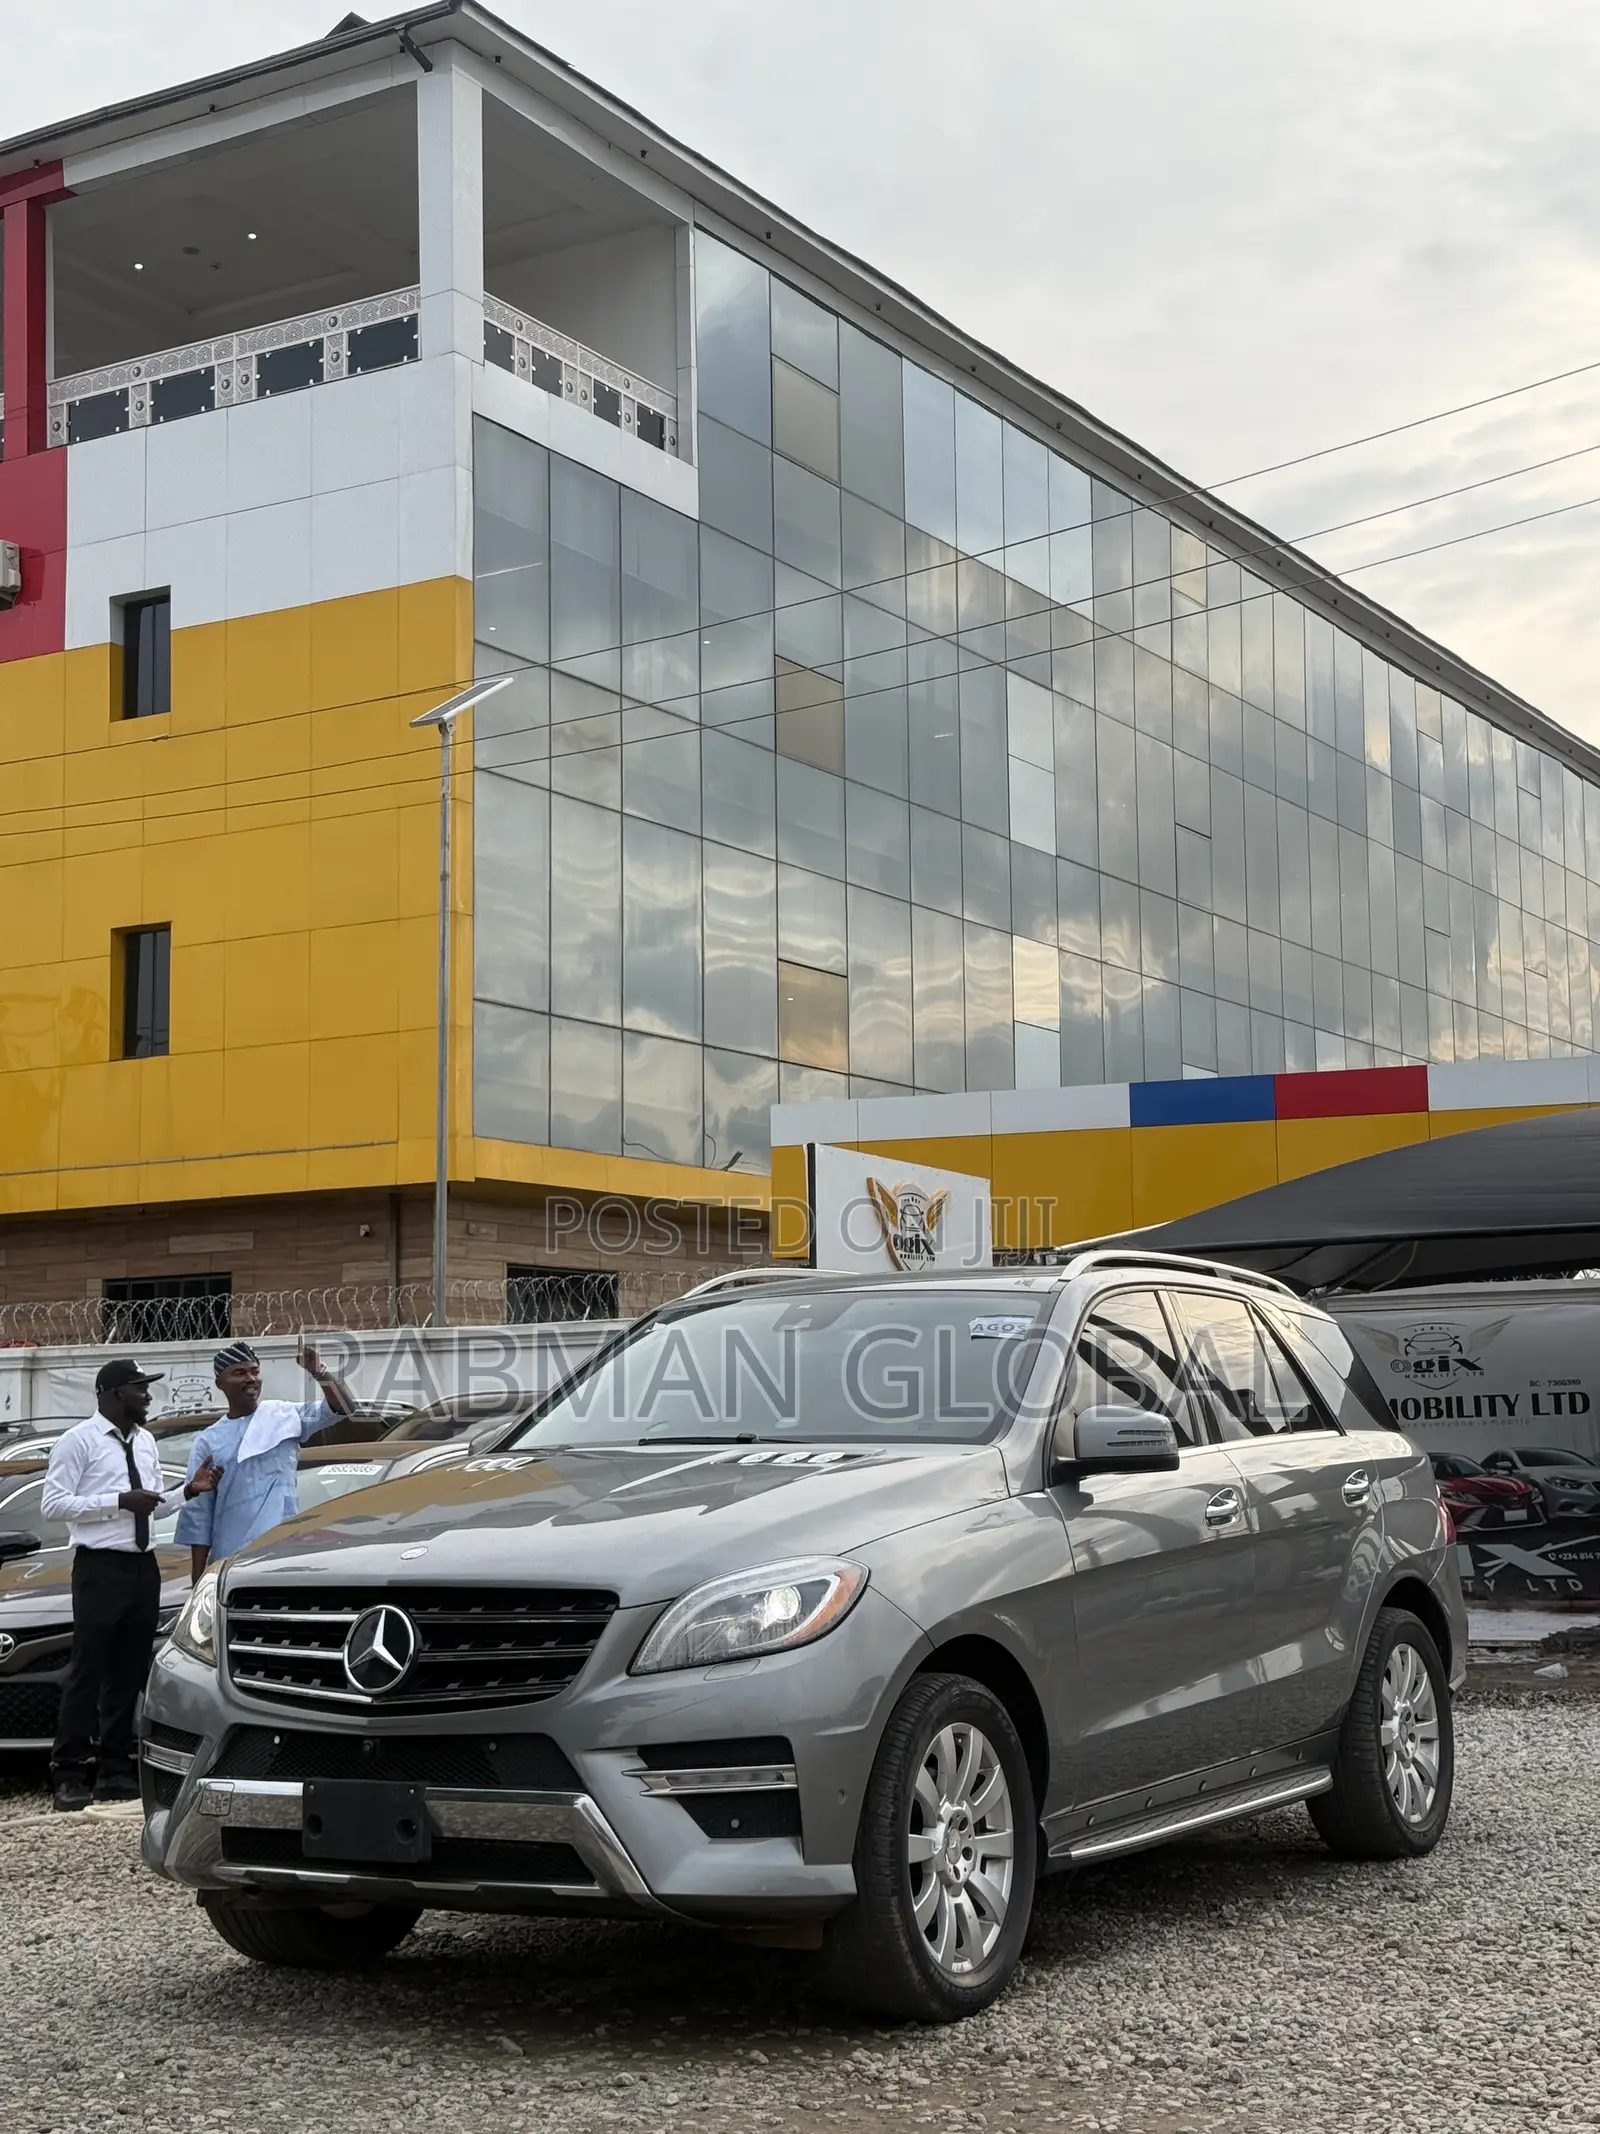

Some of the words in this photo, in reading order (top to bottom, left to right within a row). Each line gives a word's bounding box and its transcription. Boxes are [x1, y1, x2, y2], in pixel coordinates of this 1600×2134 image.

[1529, 1379, 1541, 1388] RC
[1531, 1391, 1590, 1416] LTD
[1525, 1578, 1583, 1592] LTD
